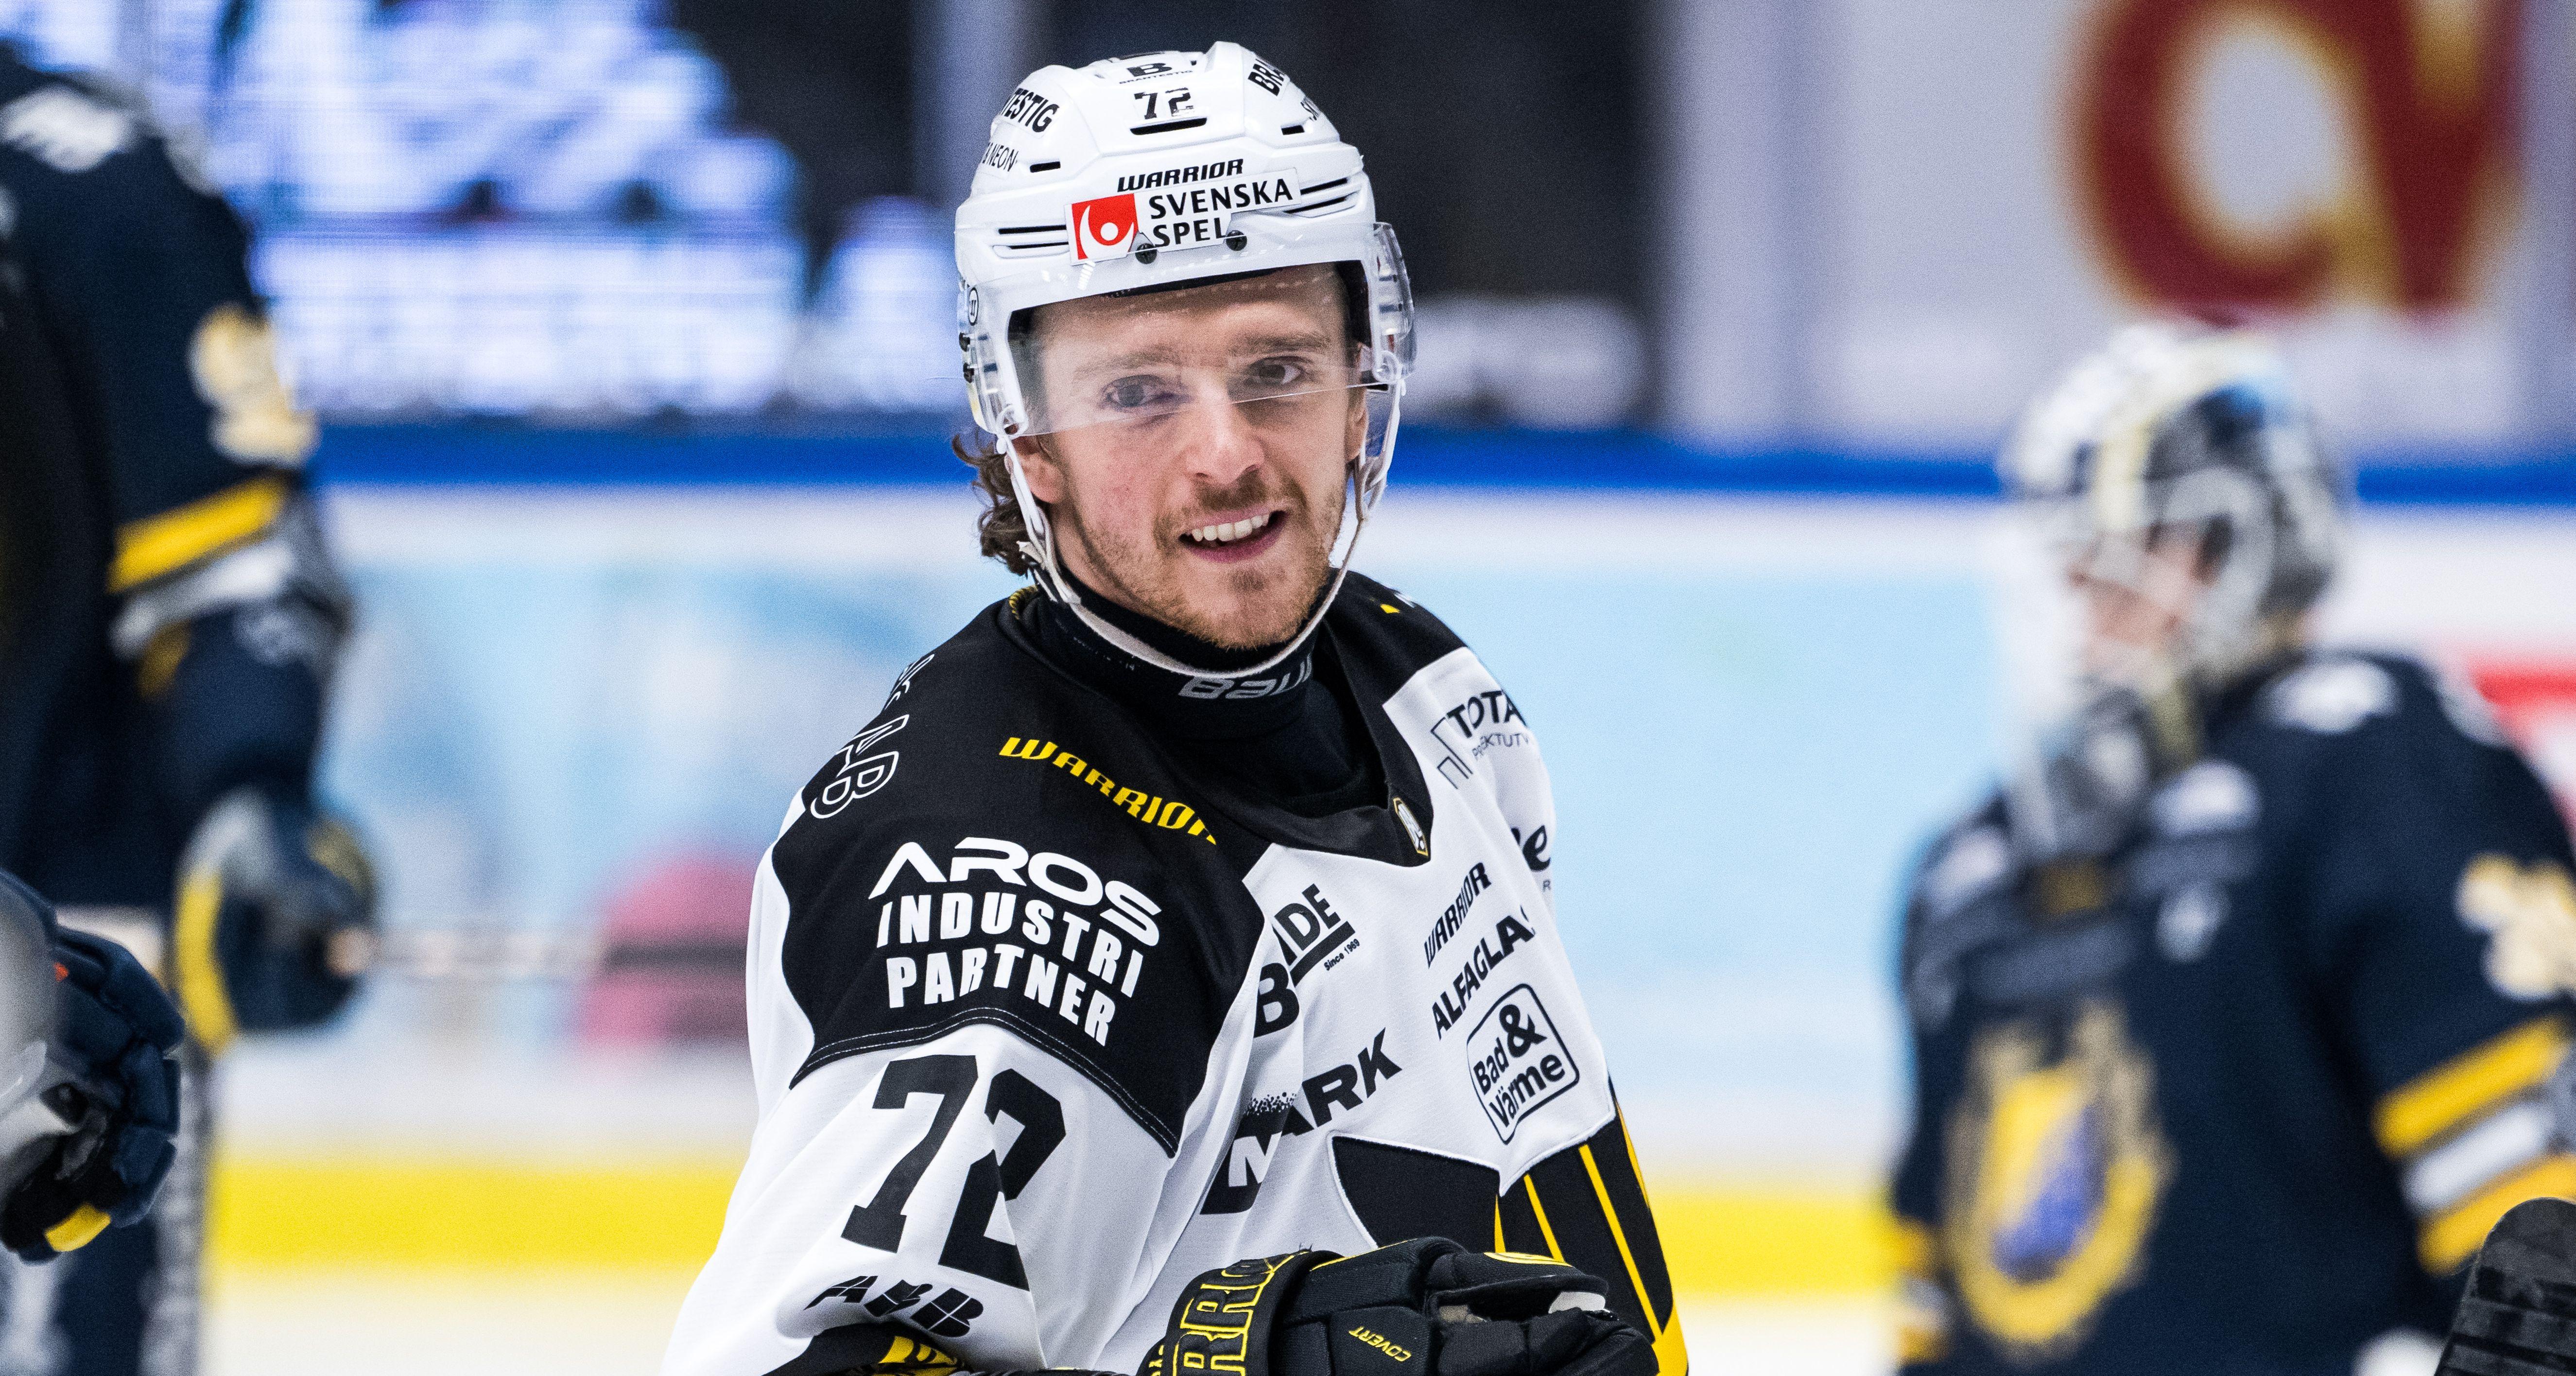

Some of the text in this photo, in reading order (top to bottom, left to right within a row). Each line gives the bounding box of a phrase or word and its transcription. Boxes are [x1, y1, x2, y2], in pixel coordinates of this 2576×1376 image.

[1126, 62, 1173, 77] B
[1001, 87, 1060, 133] TESTIG
[1133, 87, 1194, 120] 72
[986, 144, 1020, 172] NEON
[1117, 158, 1244, 193] WARRIOR
[1148, 178, 1294, 220] SVENSKA
[1153, 217, 1227, 248] SPEL
[868, 836, 1161, 946] AROS
[1424, 862, 1491, 969] WARRIOR
[877, 892, 1143, 998] INDUSTRI
[1324, 938, 1360, 971] Since 1969
[886, 943, 1117, 1047] PARTNER
[1432, 905, 1536, 1041] ALFAGLA
[1473, 1004, 1548, 1095] Bad &
[1488, 1054, 1565, 1128] Värme
[841, 1054, 1067, 1292] 72
[803, 1275, 985, 1338] ABB
[1348, 1325, 1412, 1362] COVERT
